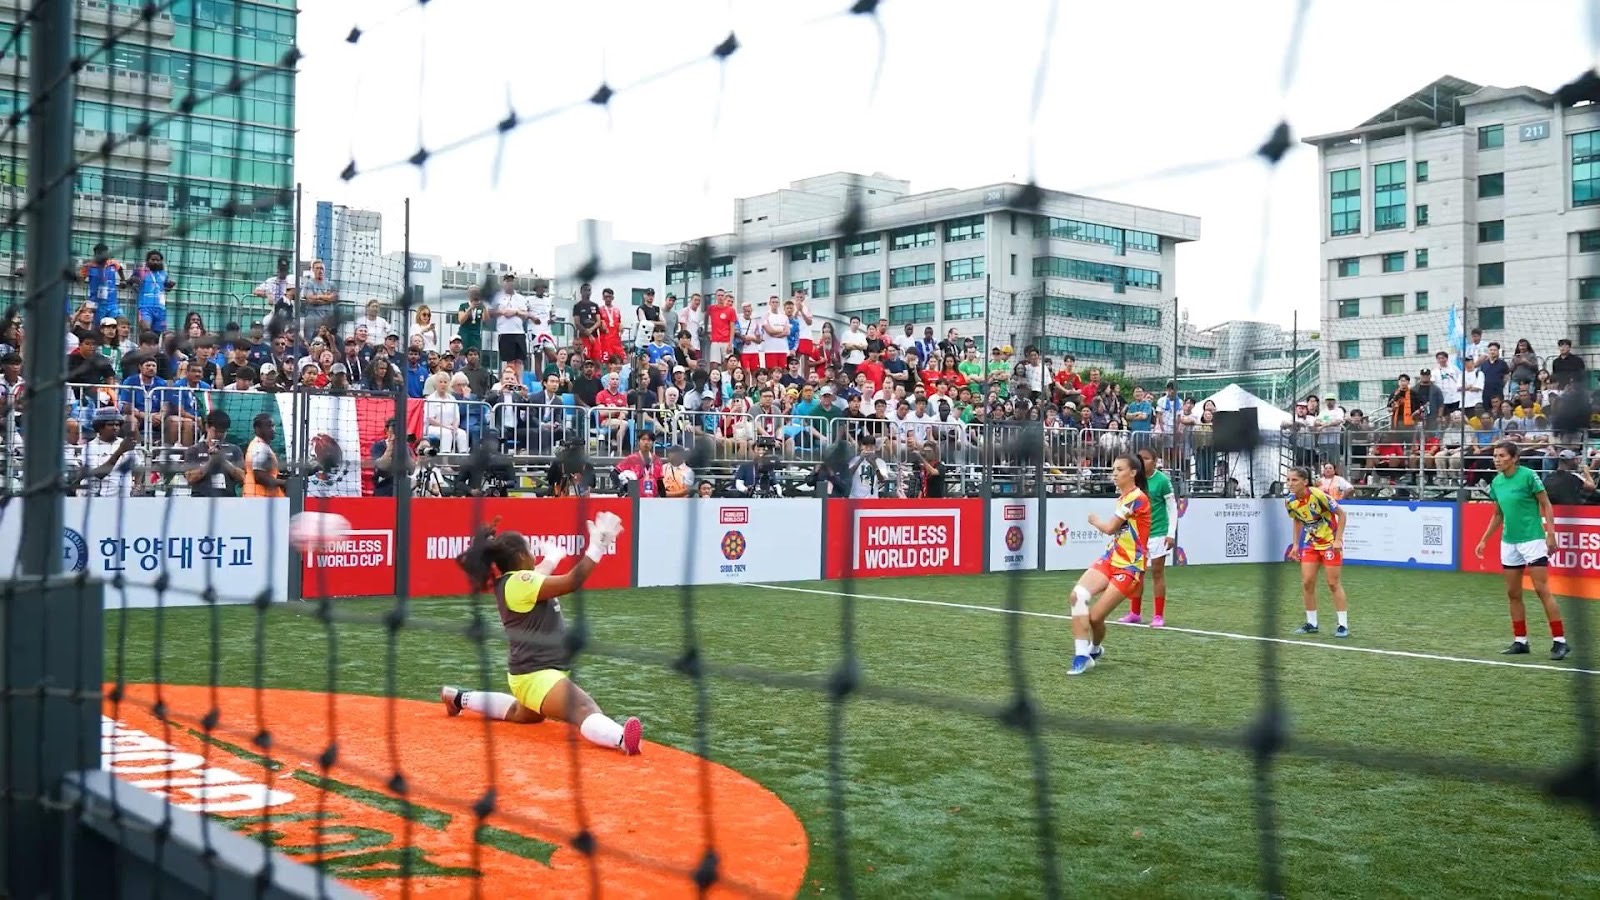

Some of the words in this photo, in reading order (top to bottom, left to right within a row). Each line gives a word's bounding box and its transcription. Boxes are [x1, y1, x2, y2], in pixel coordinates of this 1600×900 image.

[1525, 125, 1543, 137] 211
[412, 260, 428, 269] 207
[867, 525, 947, 546] HOMELESS
[100, 536, 253, 571] 한양대학교
[317, 554, 358, 568] WORLD
[360, 553, 384, 567] CUP
[864, 548, 918, 569] WORLD
[919, 546, 950, 568] CUP
[1580, 551, 1600, 570] CU
[720, 564, 733, 573] SEOUL
